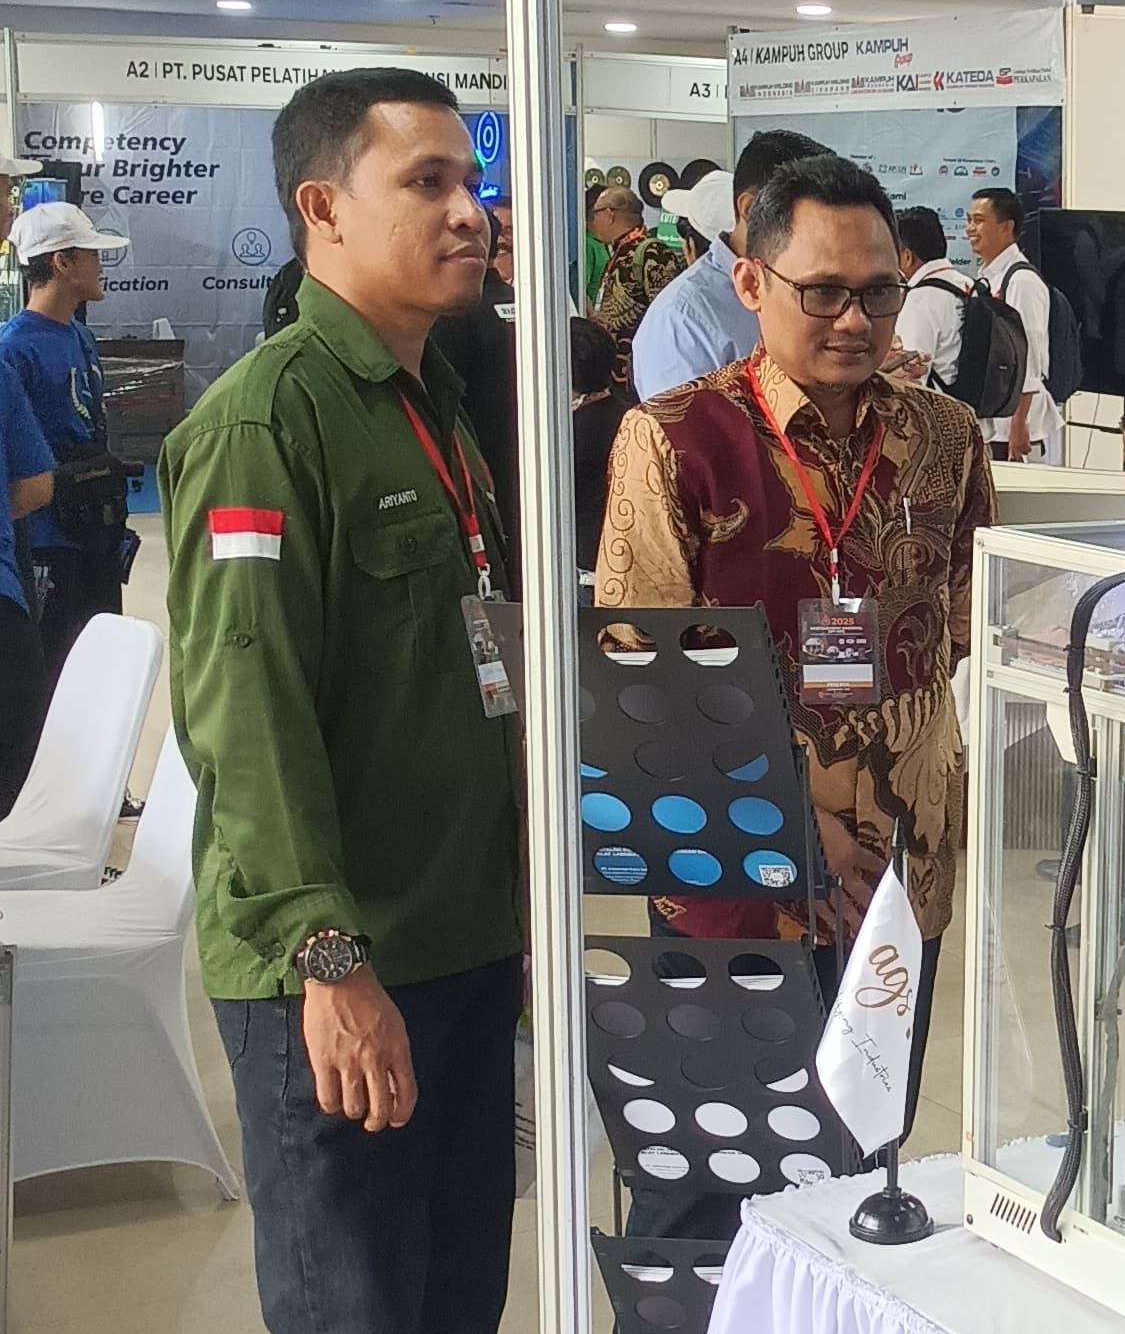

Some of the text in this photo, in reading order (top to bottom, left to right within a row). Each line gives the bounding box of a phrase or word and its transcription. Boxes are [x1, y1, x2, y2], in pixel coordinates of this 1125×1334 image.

[733, 48, 748, 66] A4
[755, 44, 805, 64] KAMPUH
[807, 41, 849, 61] GROUP
[856, 37, 909, 55] KAMPUH
[126, 61, 150, 79] A2
[162, 62, 188, 81] PT.
[192, 63, 247, 83] PUSAT
[251, 67, 337, 84] PELATIH
[455, 72, 508, 91] MANDI
[946, 70, 995, 84] KATEDA
[689, 82, 711, 99] A3
[24, 131, 187, 156] Competency
[113, 159, 221, 183] Brighter
[113, 186, 199, 205] Career
[103, 275, 273, 292] ication Consult
[378, 489, 418, 511] ARIYANTO
